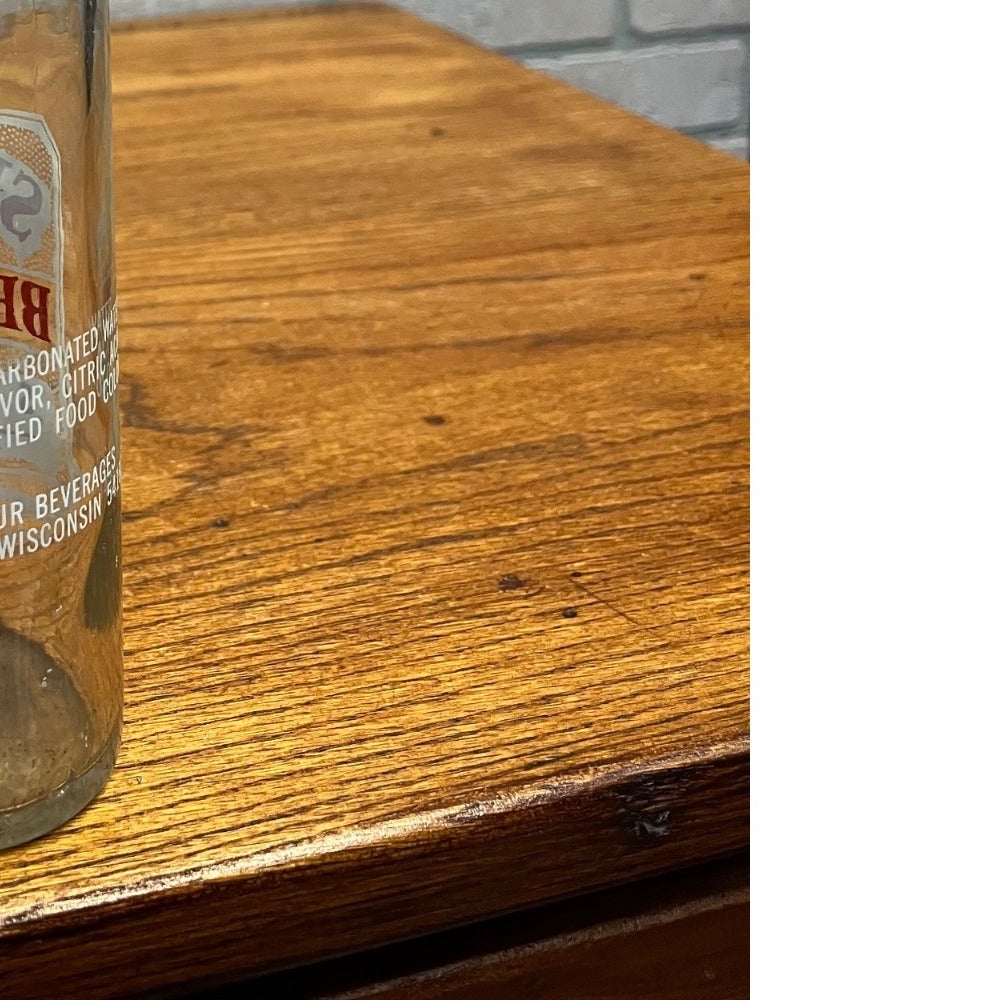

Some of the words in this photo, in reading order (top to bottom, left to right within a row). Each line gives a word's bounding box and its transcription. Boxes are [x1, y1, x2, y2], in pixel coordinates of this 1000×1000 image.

[62, 350, 107, 399] CITRIC
[55, 390, 97, 434] FOOD
[35, 445, 117, 519] BEVERAGES
